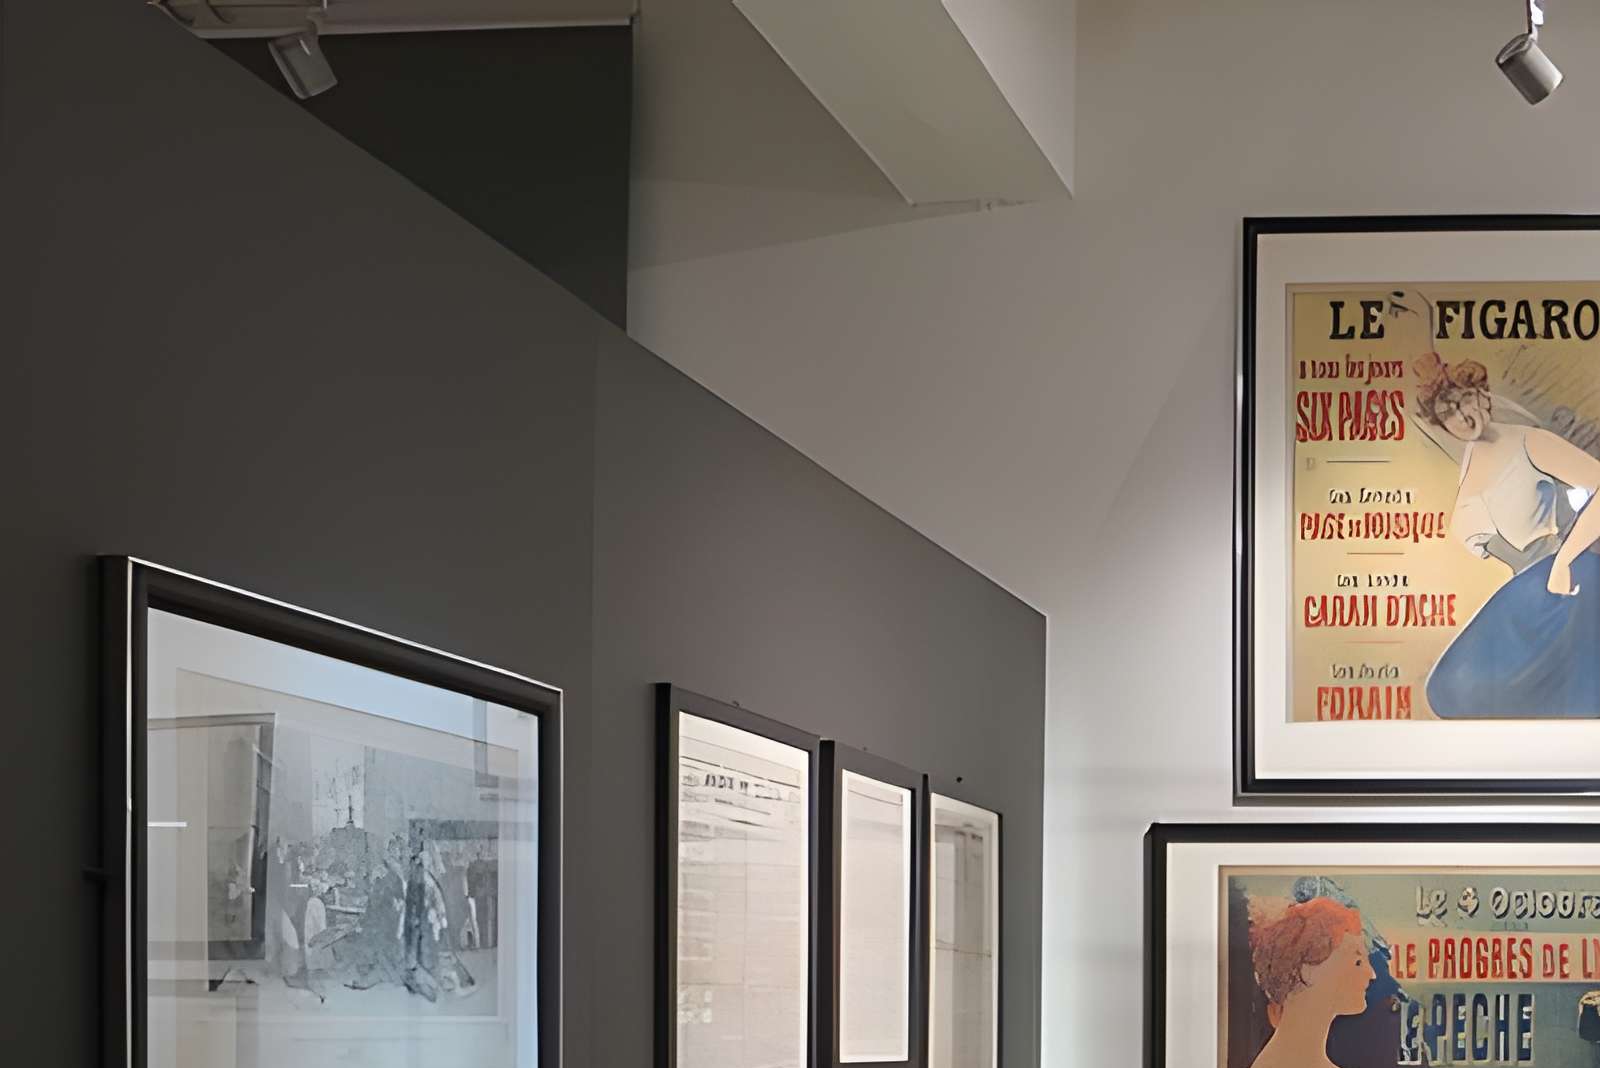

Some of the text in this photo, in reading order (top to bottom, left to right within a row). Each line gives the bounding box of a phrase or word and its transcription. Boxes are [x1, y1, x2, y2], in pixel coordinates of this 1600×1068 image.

[1329, 299, 1600, 341] LE FIGARO
[1393, 943, 1417, 979] LE
[1542, 943, 1570, 979] DE
